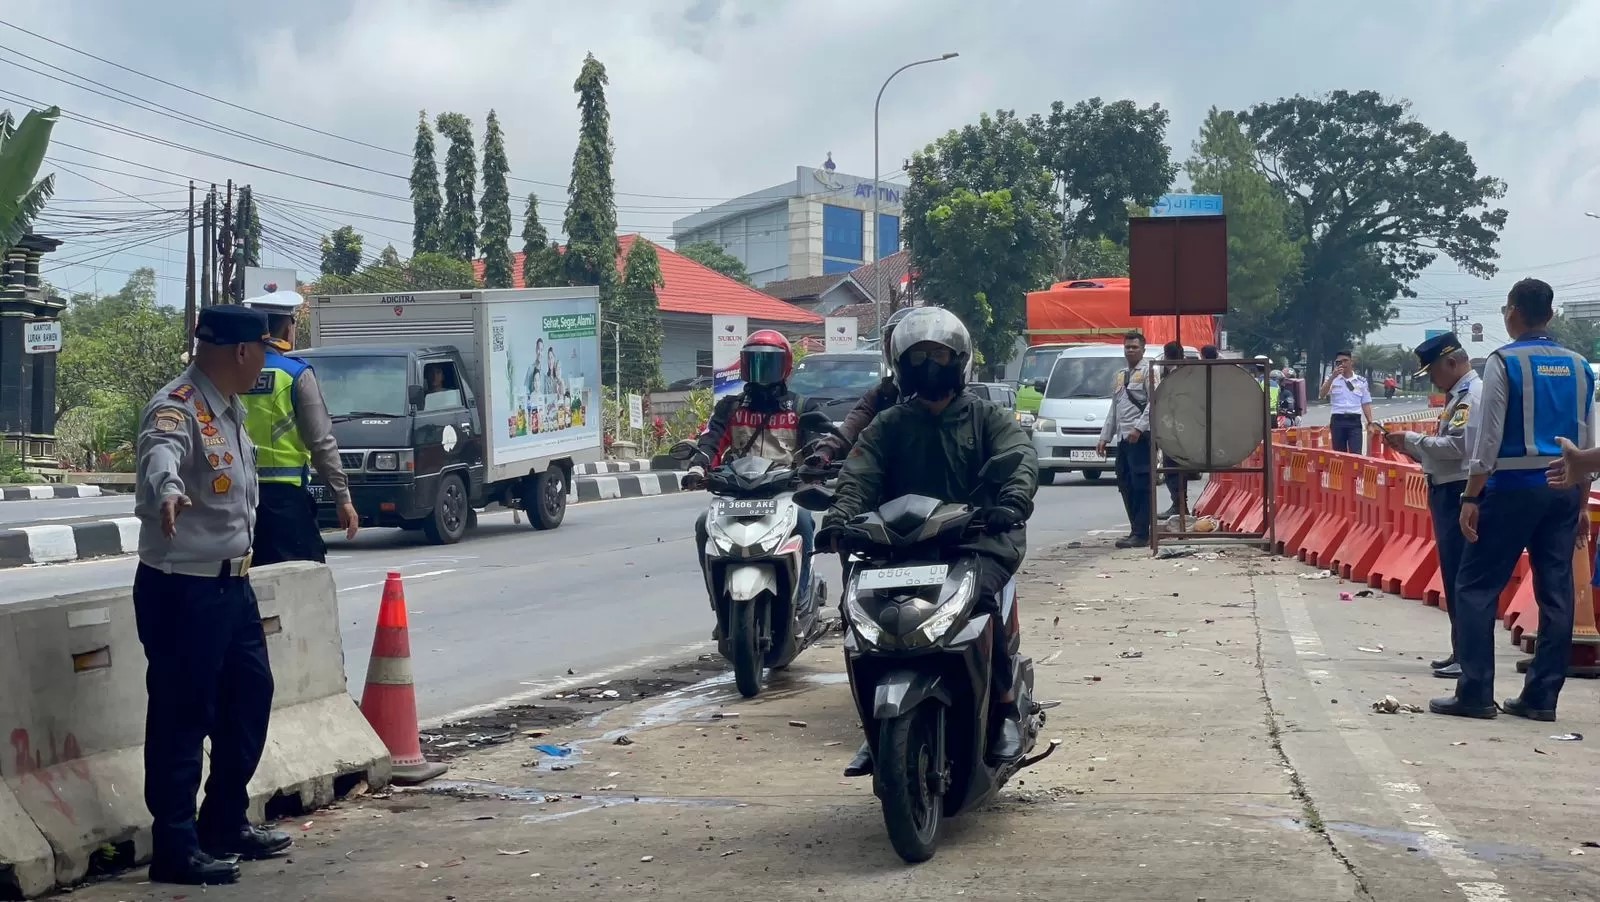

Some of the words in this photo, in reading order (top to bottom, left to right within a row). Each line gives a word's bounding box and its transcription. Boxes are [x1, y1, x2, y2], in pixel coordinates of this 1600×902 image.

[381, 295, 416, 304] ADICITRA
[719, 501, 725, 509] H
[728, 501, 752, 509] 3606
